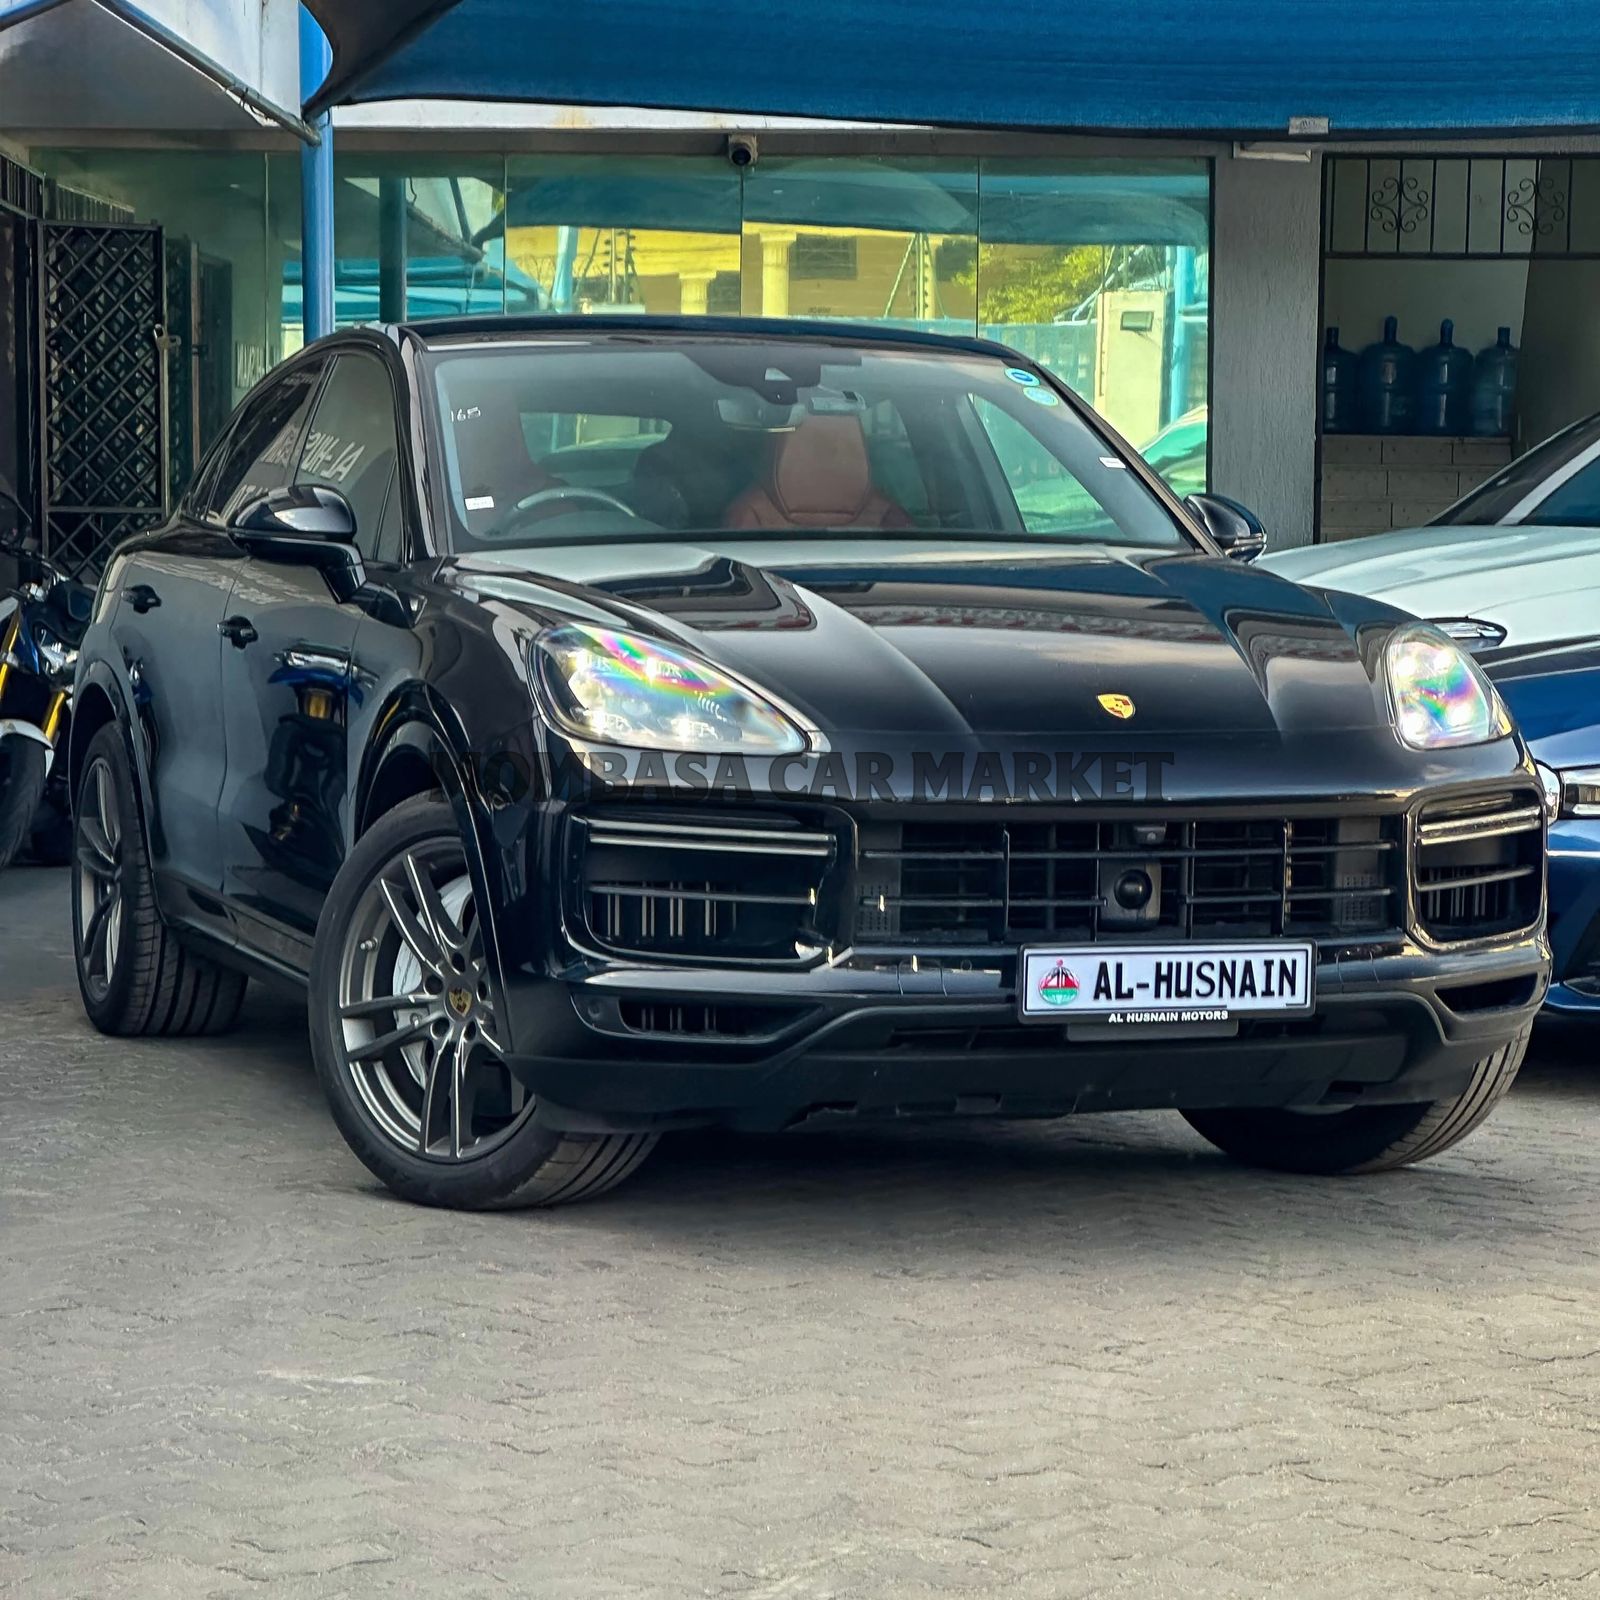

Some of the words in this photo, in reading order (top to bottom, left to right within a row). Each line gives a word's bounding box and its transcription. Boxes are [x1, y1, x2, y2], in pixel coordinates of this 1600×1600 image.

[1093, 959, 1297, 1002] AL-HUSNAIN
[1108, 1013, 1124, 1023] AL
[1126, 1012, 1179, 1023] HUSNAIN
[1181, 1010, 1229, 1021] MOTORS
